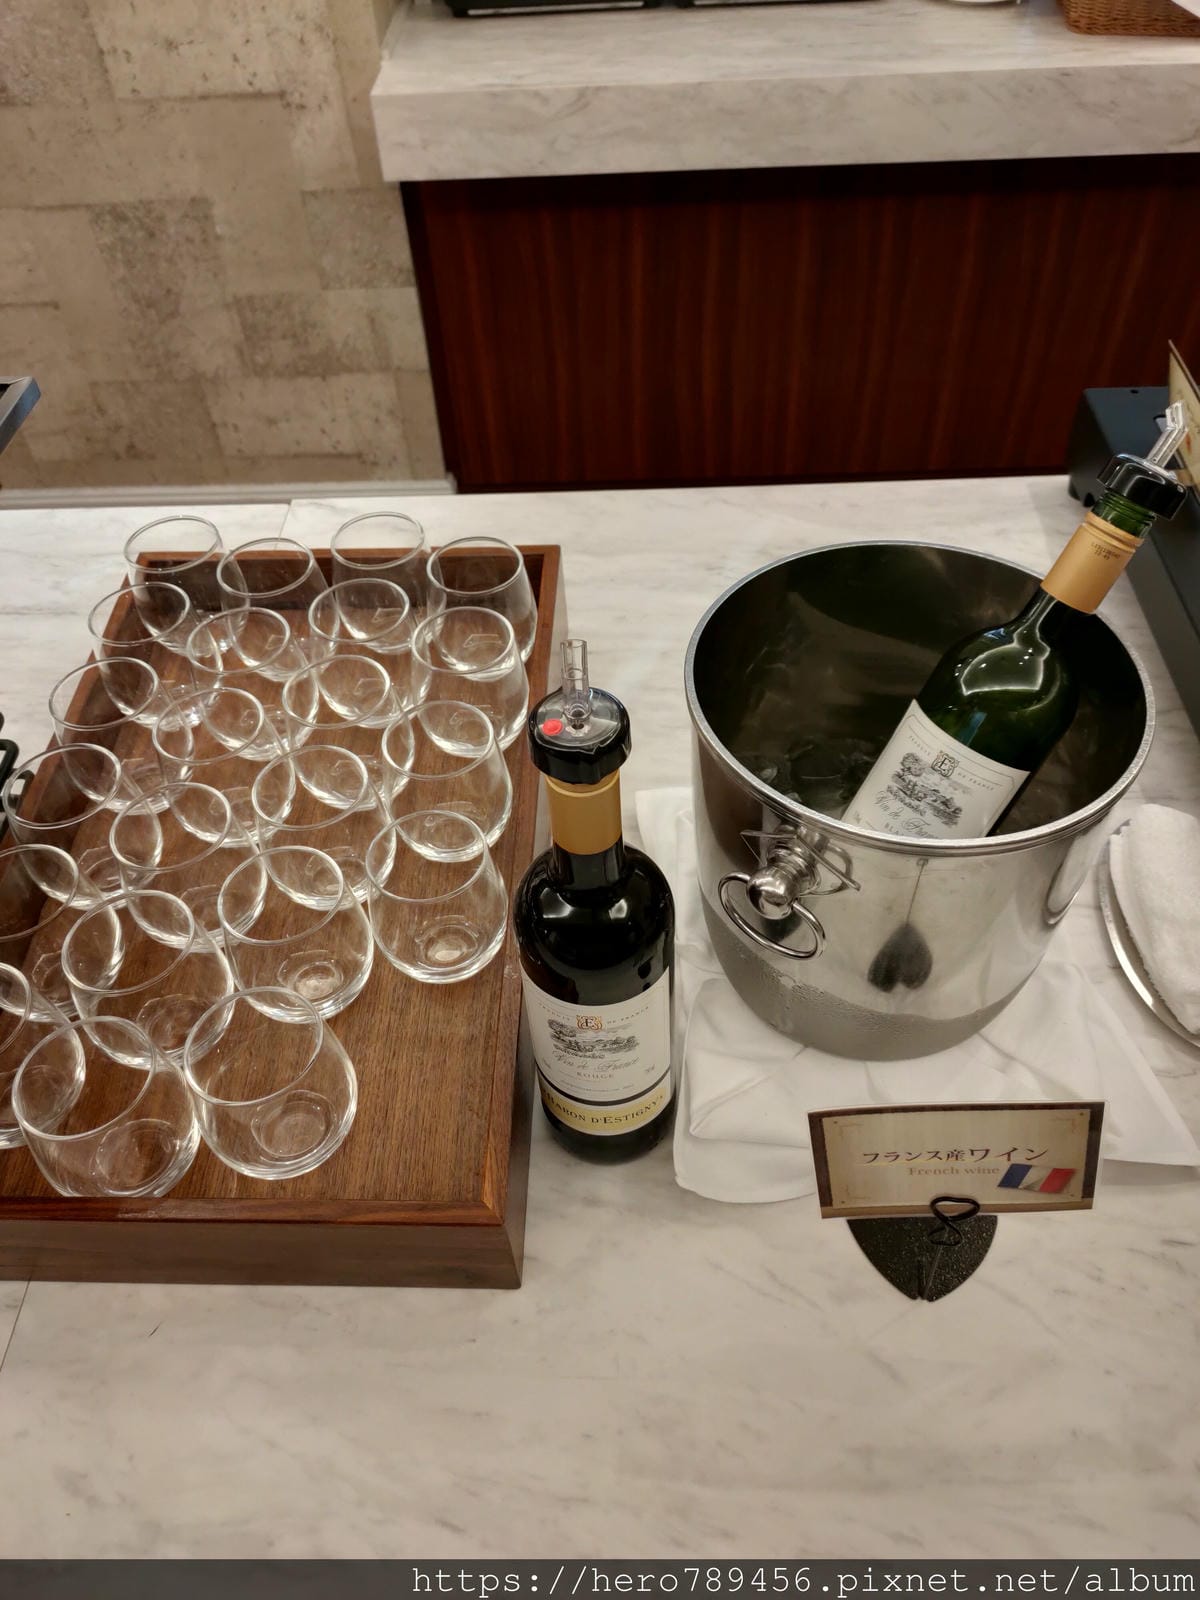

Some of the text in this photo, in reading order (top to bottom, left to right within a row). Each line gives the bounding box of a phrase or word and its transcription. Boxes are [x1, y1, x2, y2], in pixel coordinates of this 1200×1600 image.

[901, 817, 939, 838] Fran
[576, 1071, 615, 1080] ROUGE
[862, 1147, 1049, 1164] フランス産ワイン
[907, 1165, 1001, 1177] French wine
